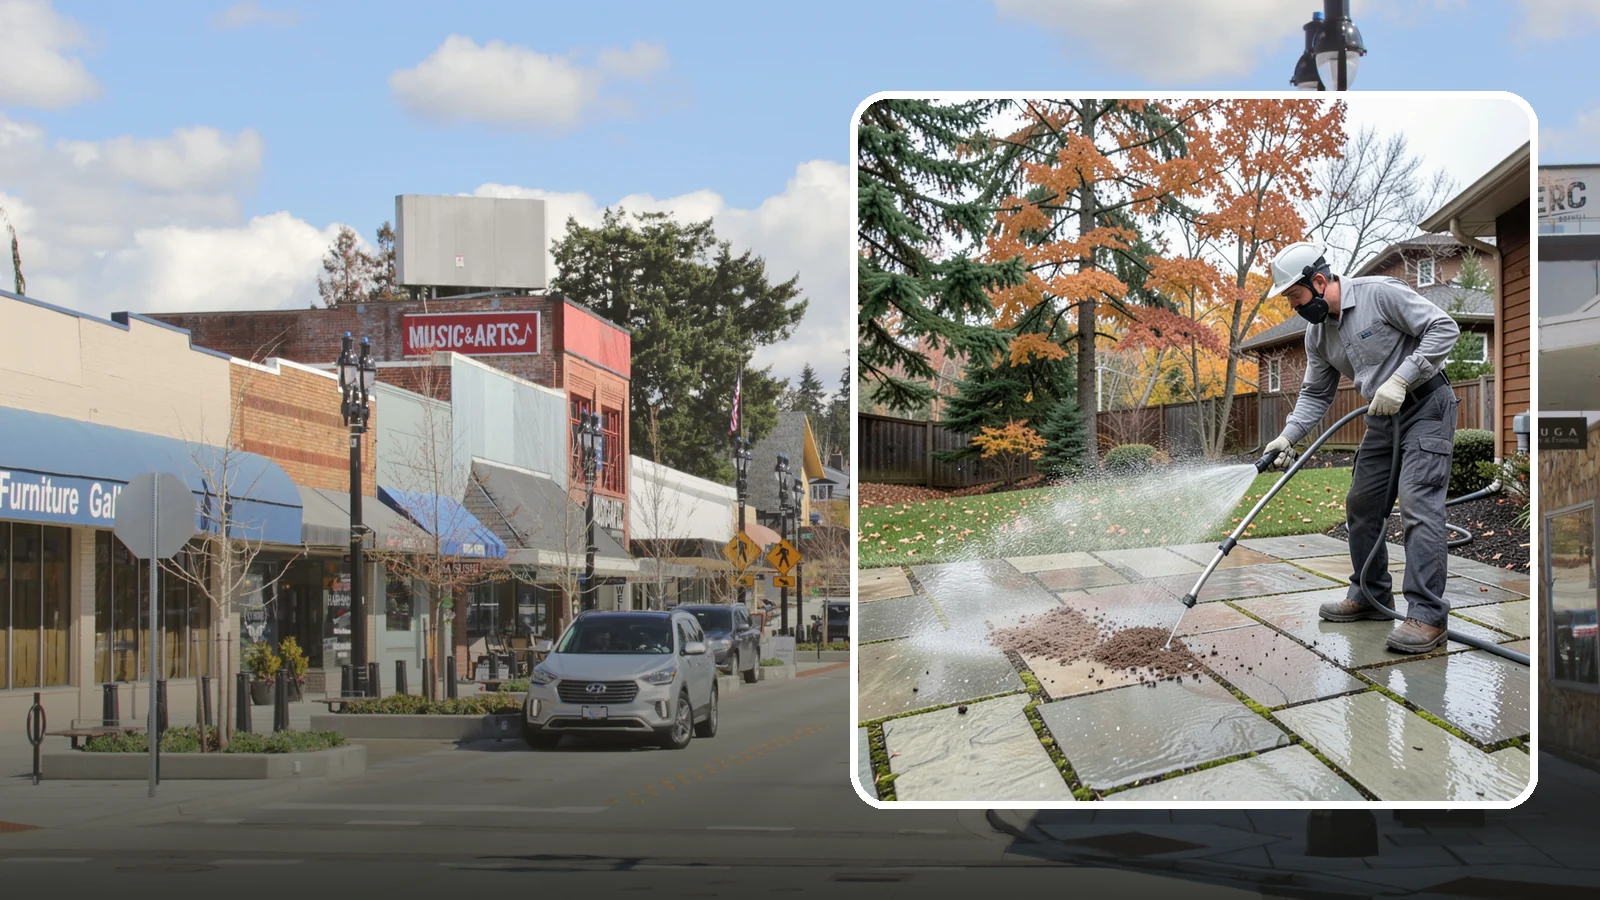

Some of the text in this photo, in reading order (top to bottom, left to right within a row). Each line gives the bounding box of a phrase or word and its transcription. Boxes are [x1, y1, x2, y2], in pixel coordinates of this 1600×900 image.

[408, 323, 519, 349] MUSIC&ARTS
[0, 471, 122, 519] Furniture Gal
